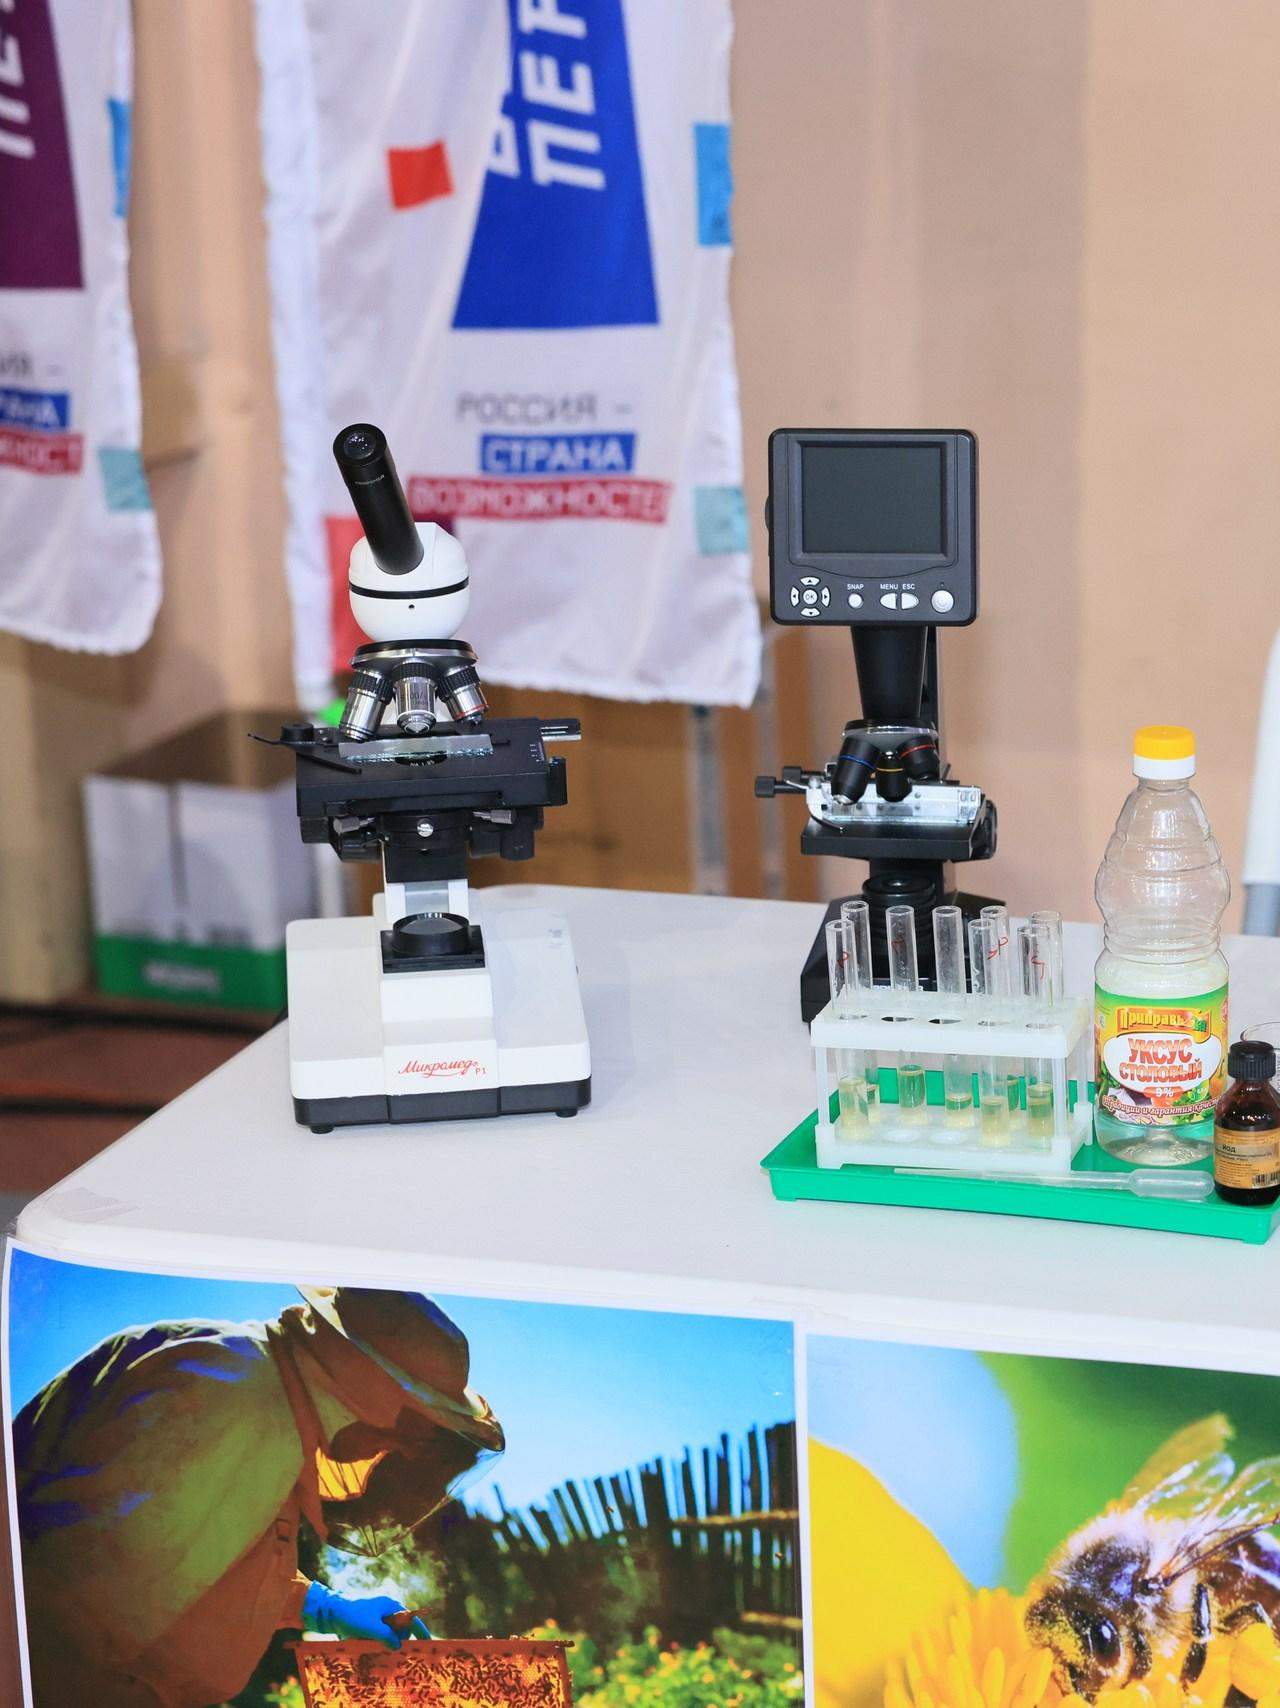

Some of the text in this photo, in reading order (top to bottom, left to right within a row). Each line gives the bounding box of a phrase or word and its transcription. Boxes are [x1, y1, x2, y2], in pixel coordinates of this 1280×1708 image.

[456, 392, 598, 424] РОССИЯ
[485, 438, 626, 472] СТРАНА
[1128, 1038, 1193, 1065] УКСУС
[1119, 1058, 1203, 1083] СТОЛОВЫЙ
[1155, 1087, 1174, 1097] 9%
